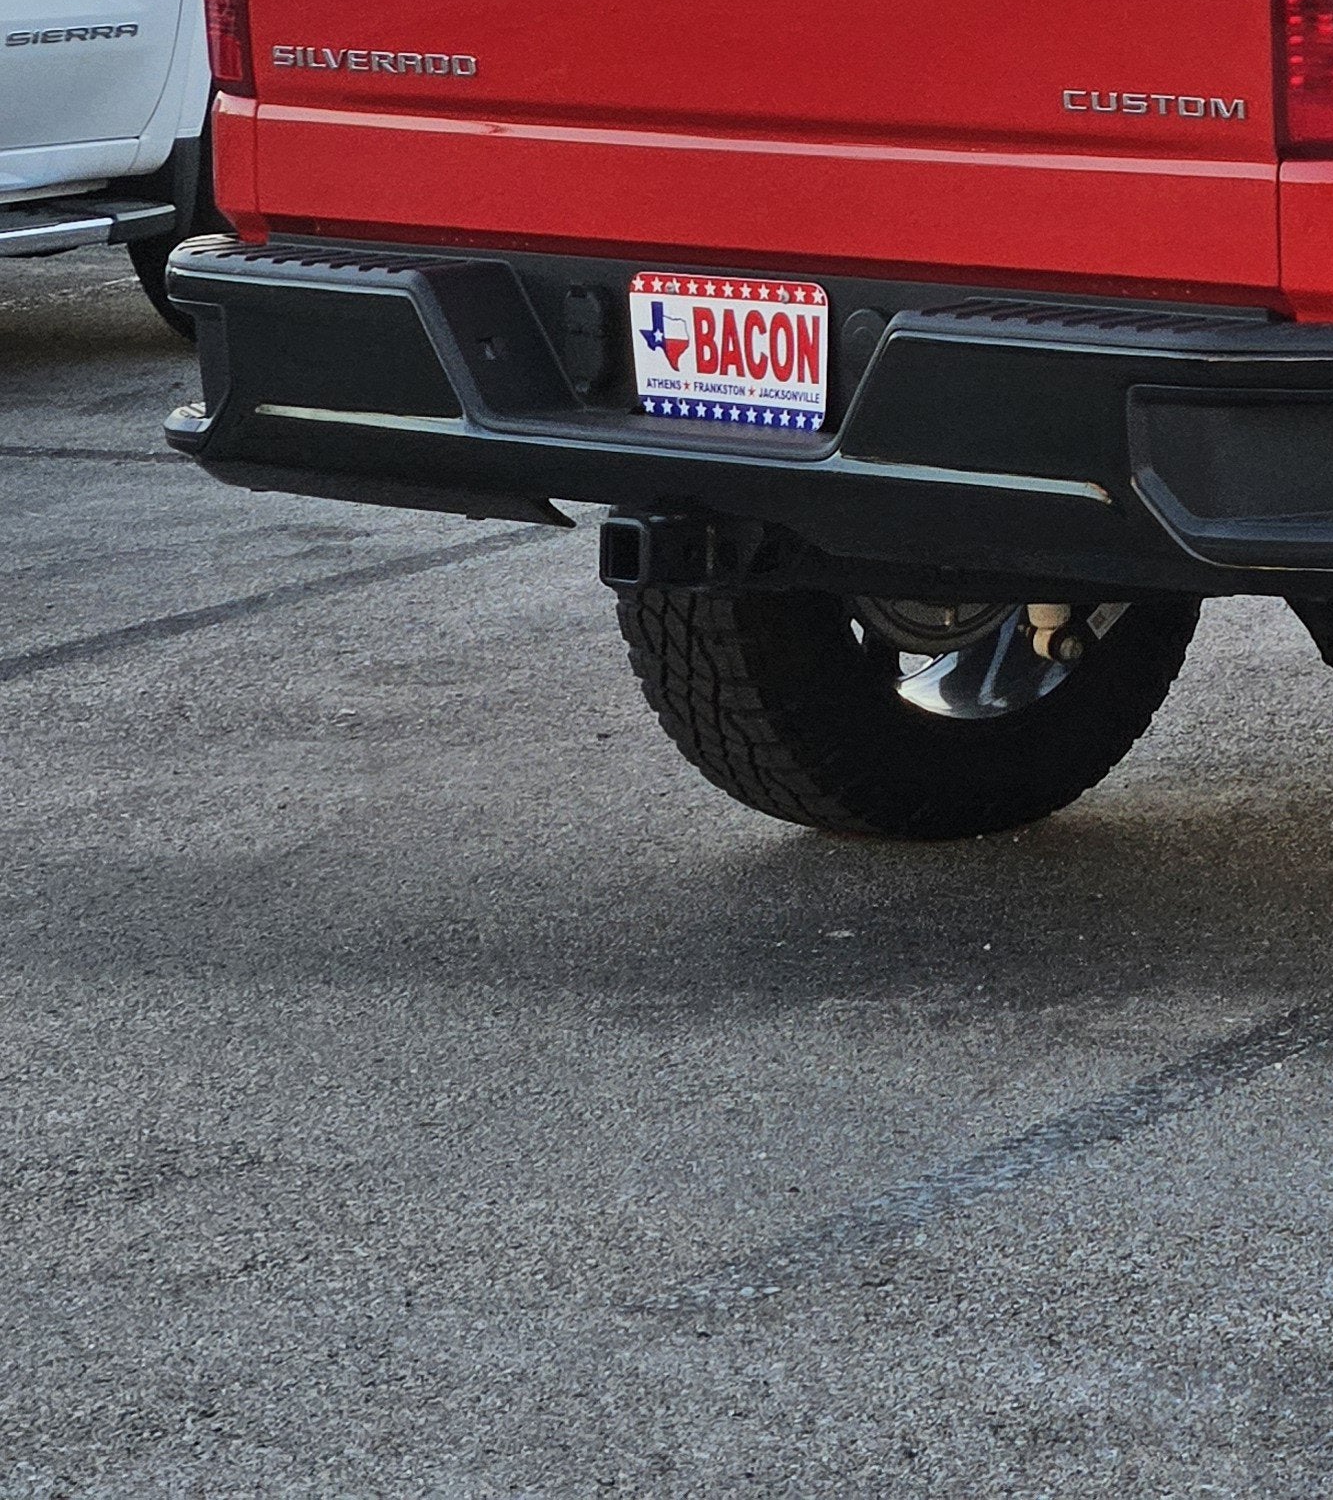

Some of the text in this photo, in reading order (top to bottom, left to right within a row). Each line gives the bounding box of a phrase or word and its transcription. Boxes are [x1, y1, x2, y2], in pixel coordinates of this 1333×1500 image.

[5, 21, 138, 47] SIERRA
[272, 45, 477, 76] SILVERADO
[1063, 90, 1246, 120] CUSTOM
[692, 306, 820, 384] BACON
[646, 378, 820, 404] ATHENS FRANKSTON JACKSONVILLE
